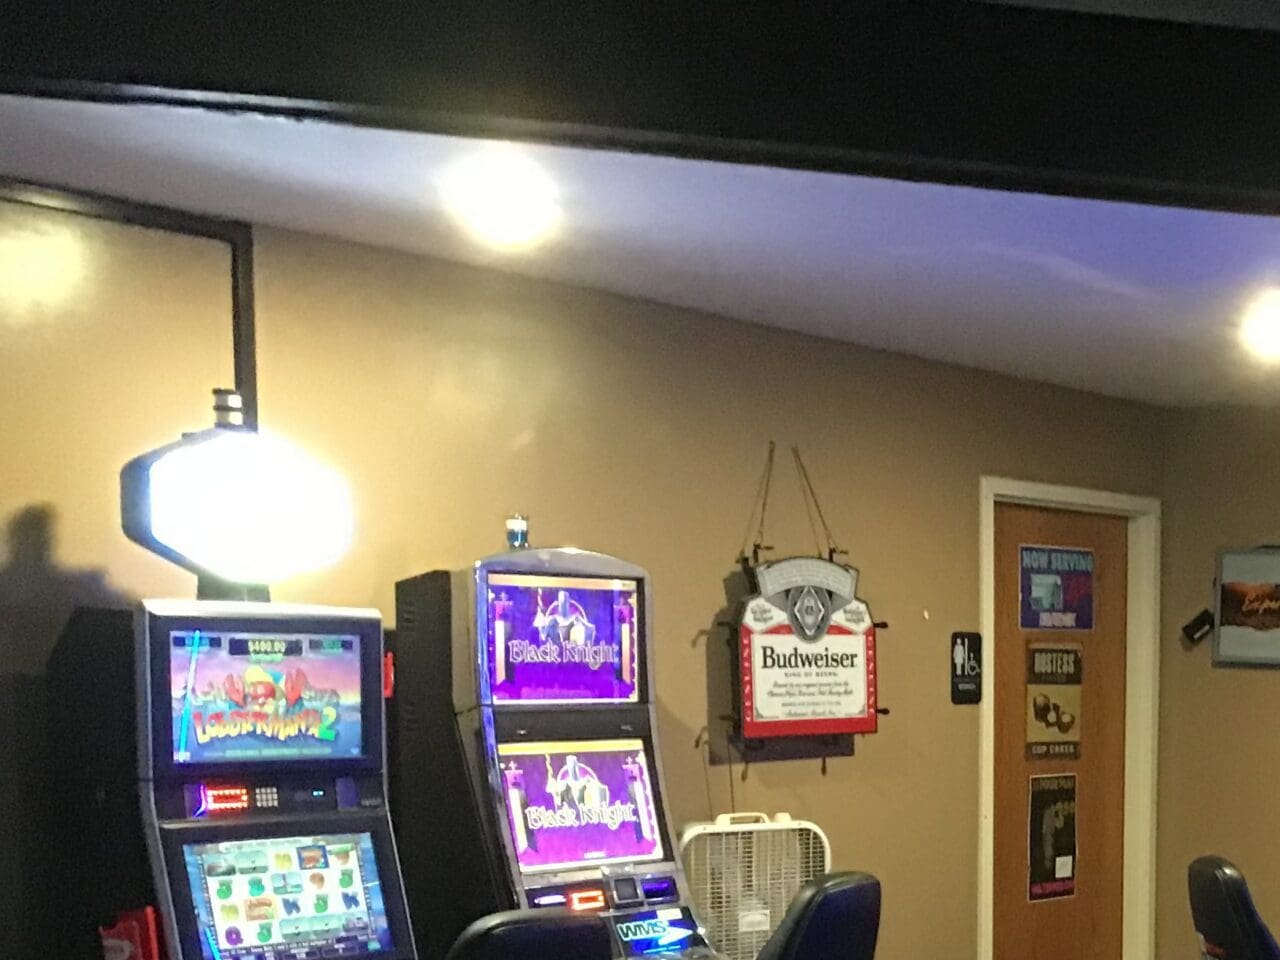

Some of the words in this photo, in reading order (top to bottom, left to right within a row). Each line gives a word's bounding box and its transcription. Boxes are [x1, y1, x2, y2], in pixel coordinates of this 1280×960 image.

[1022, 550, 1048, 569] NOW
[1050, 551, 1094, 572] SERVING
[508, 640, 561, 664] Black
[562, 640, 619, 670] Knight
[761, 645, 858, 669] Budweiser
[1033, 652, 1076, 674] HOSTESS
[318, 706, 337, 741] 2
[525, 805, 578, 830] Black
[580, 800, 638, 831] Knight
[617, 920, 667, 940] WMS
